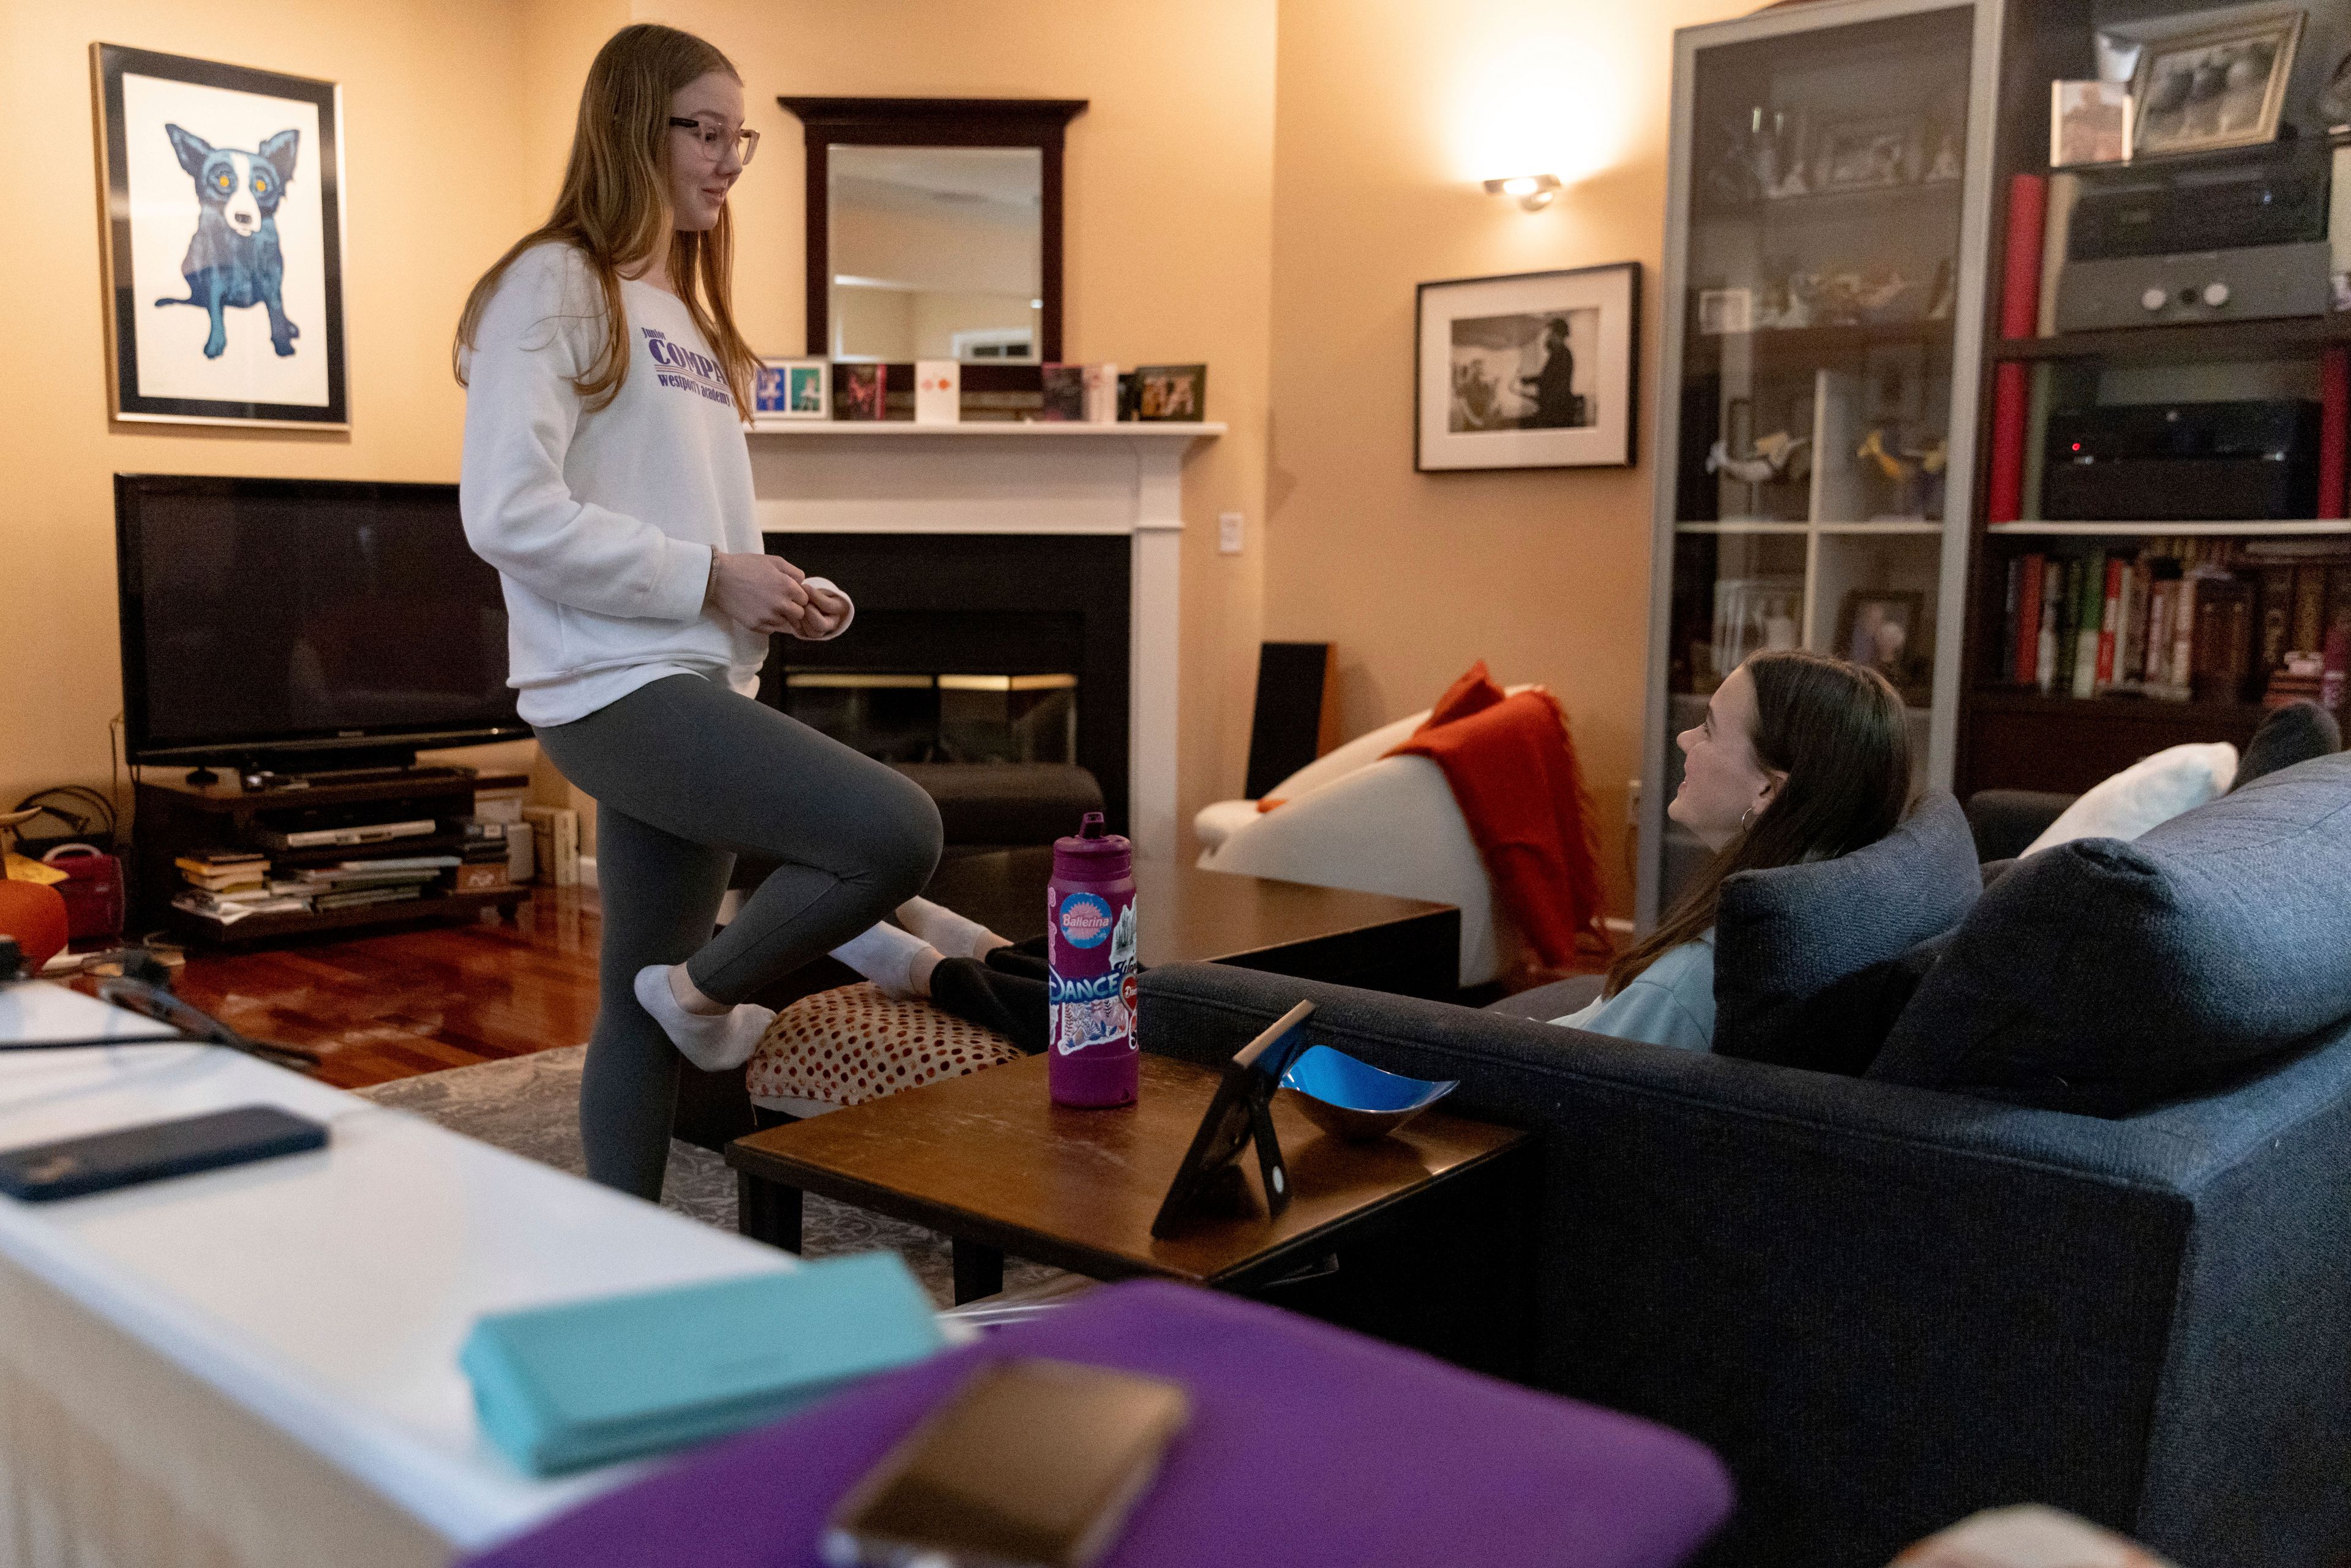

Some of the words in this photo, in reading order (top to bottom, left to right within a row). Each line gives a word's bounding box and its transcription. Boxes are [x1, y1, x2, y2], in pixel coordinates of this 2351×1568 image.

[649, 339, 729, 386] COMPA
[701, 386, 730, 407] academy
[1063, 913, 1109, 927] Ballerina
